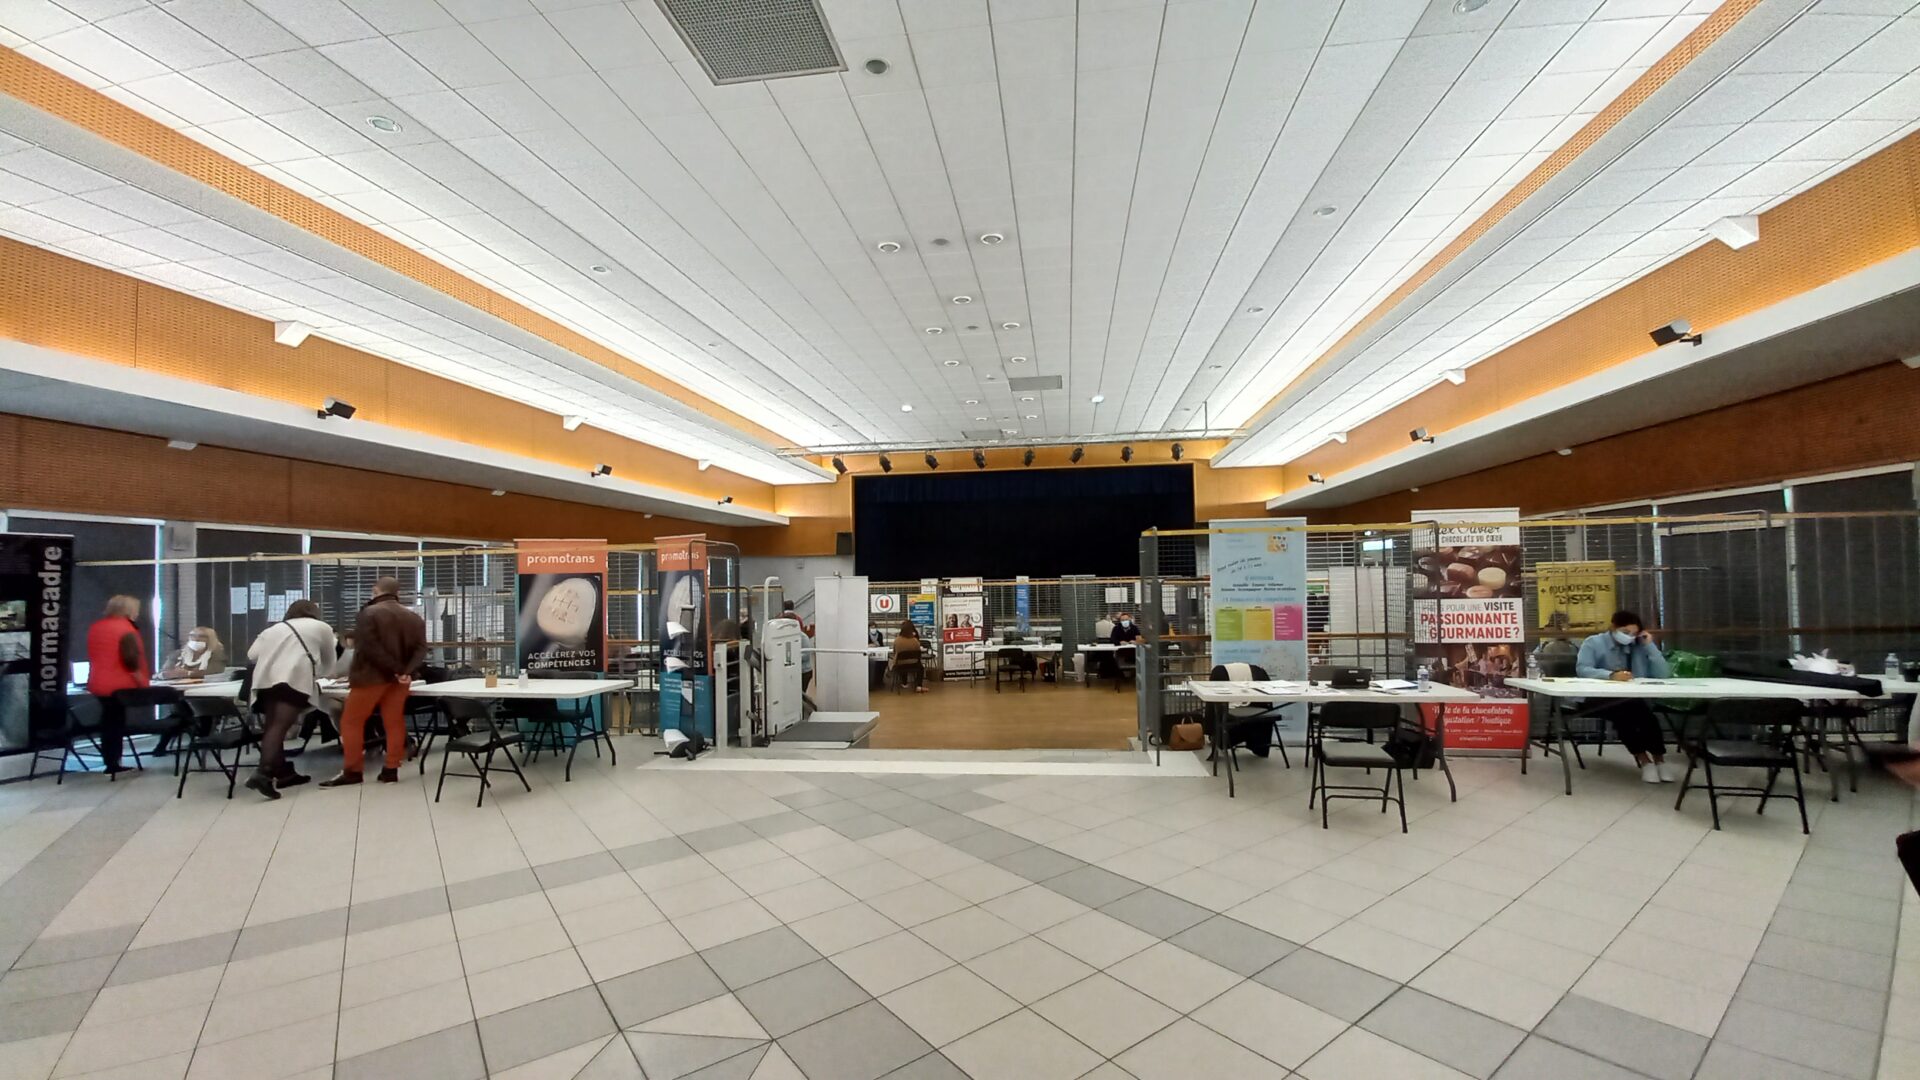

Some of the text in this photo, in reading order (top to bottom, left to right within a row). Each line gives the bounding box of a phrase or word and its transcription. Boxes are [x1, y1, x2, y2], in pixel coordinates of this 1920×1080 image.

[527, 552, 595, 567] promotrans
[661, 549, 700, 564] promotrns
[879, 599, 890, 609] U
[1484, 601, 1514, 611] VISITE
[38, 546, 62, 692] normacadre
[1421, 612, 1518, 625] PASSIONNANTE
[1430, 627, 1511, 639] GOURMANDE
[1513, 626, 1520, 638] ?
[579, 649, 596, 657] VOS
[528, 659, 591, 670] COMPÉTENCES
